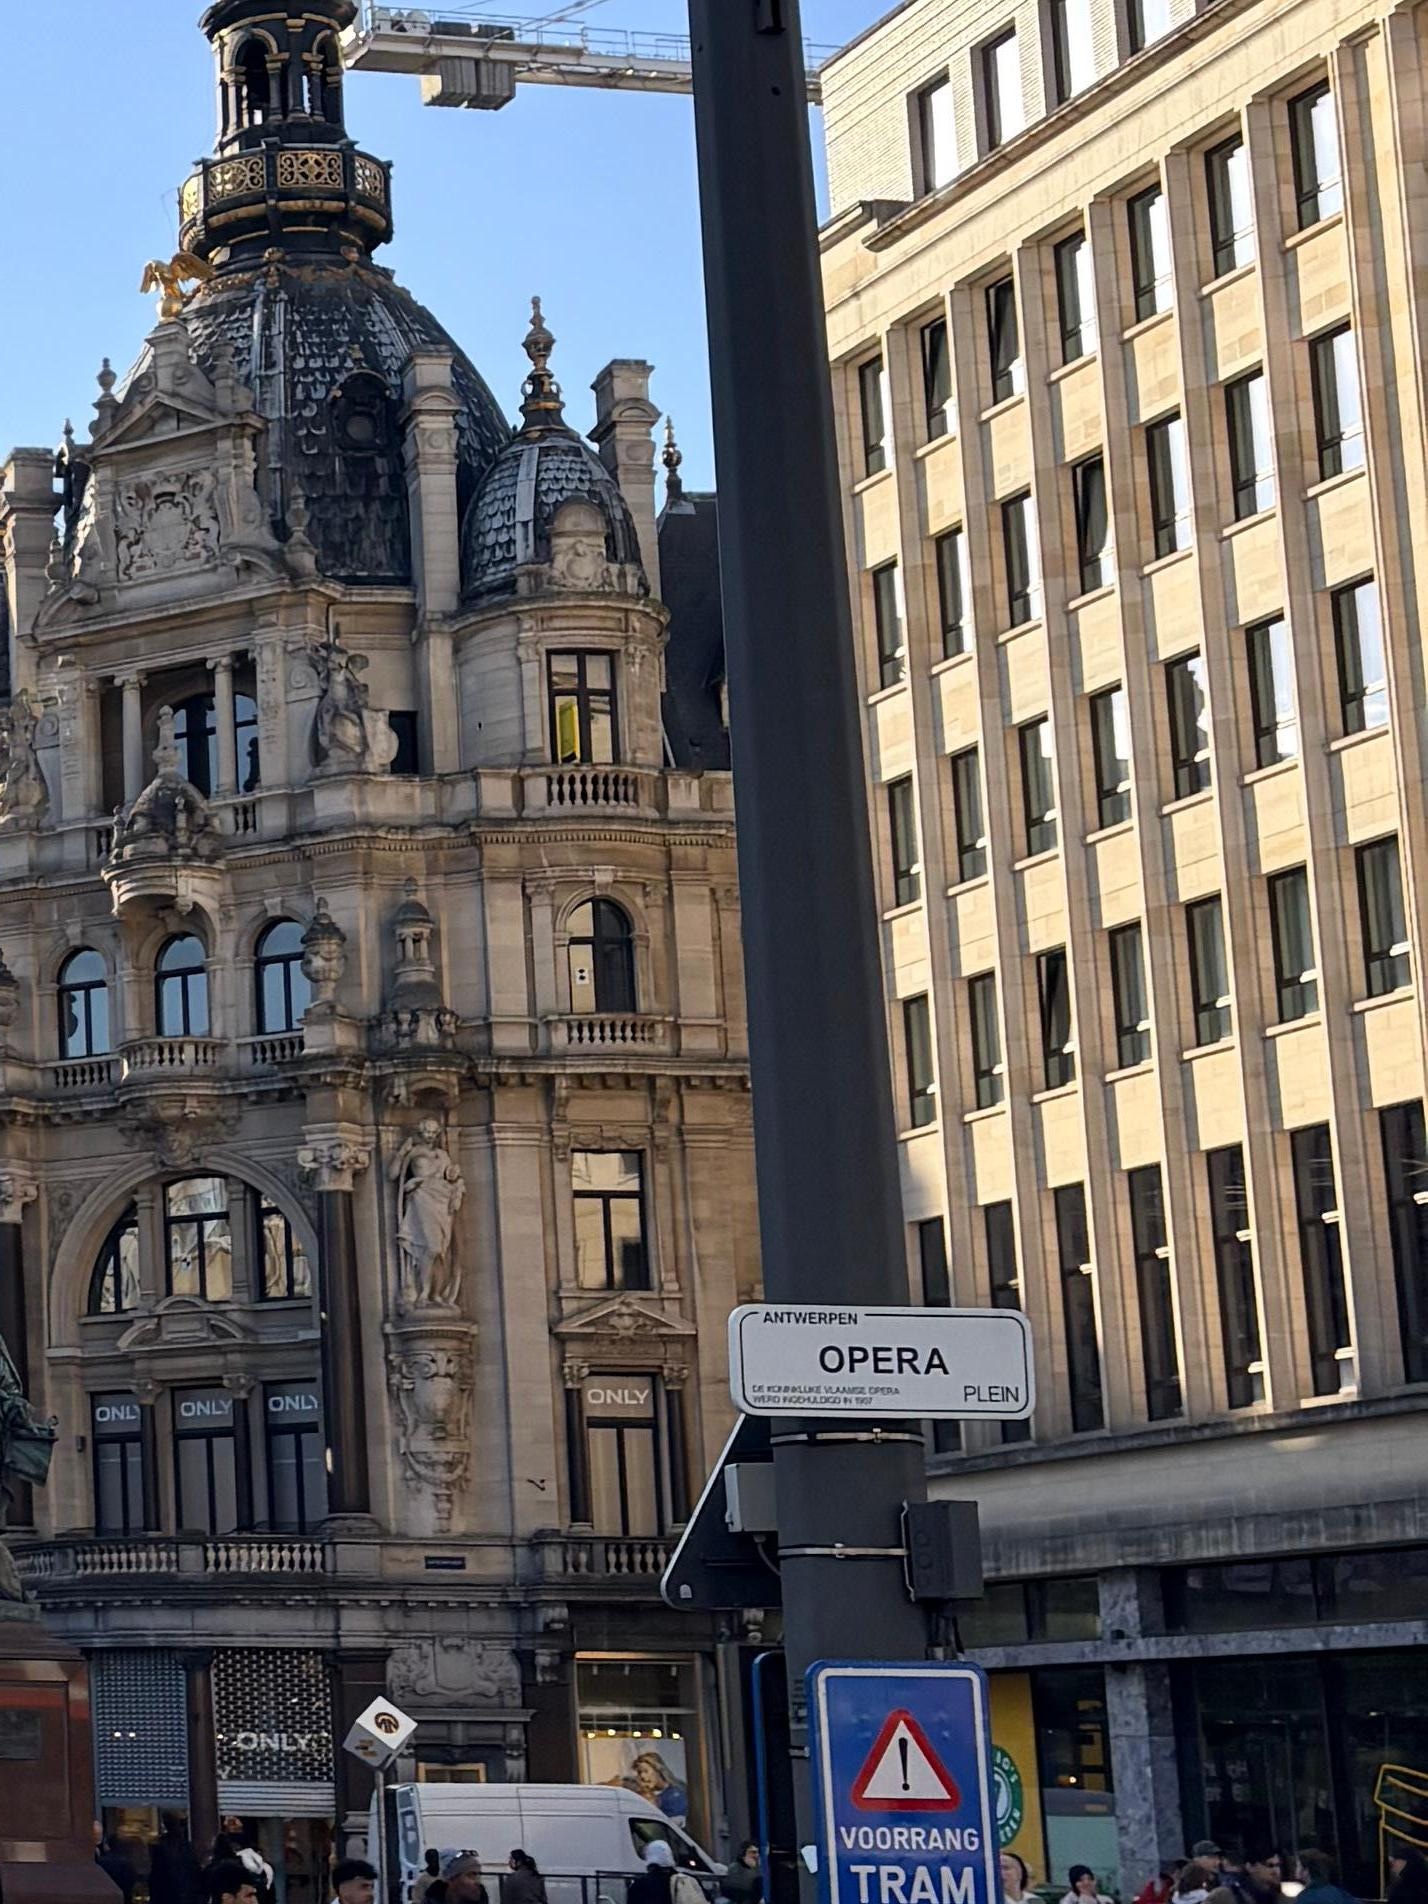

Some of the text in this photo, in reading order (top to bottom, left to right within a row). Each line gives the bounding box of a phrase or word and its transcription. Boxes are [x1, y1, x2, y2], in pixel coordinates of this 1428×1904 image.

[763, 1311, 858, 1326] ANTWERPEN
[818, 1345, 950, 1375] OPERA
[587, 1388, 649, 1405] ONLY
[869, 1386, 901, 1395] OPERA
[963, 1384, 1023, 1404] PLEIN
[180, 1398, 233, 1417] ONLY
[237, 1731, 313, 1752] ONLY
[839, 1826, 980, 1852] VOORRANG
